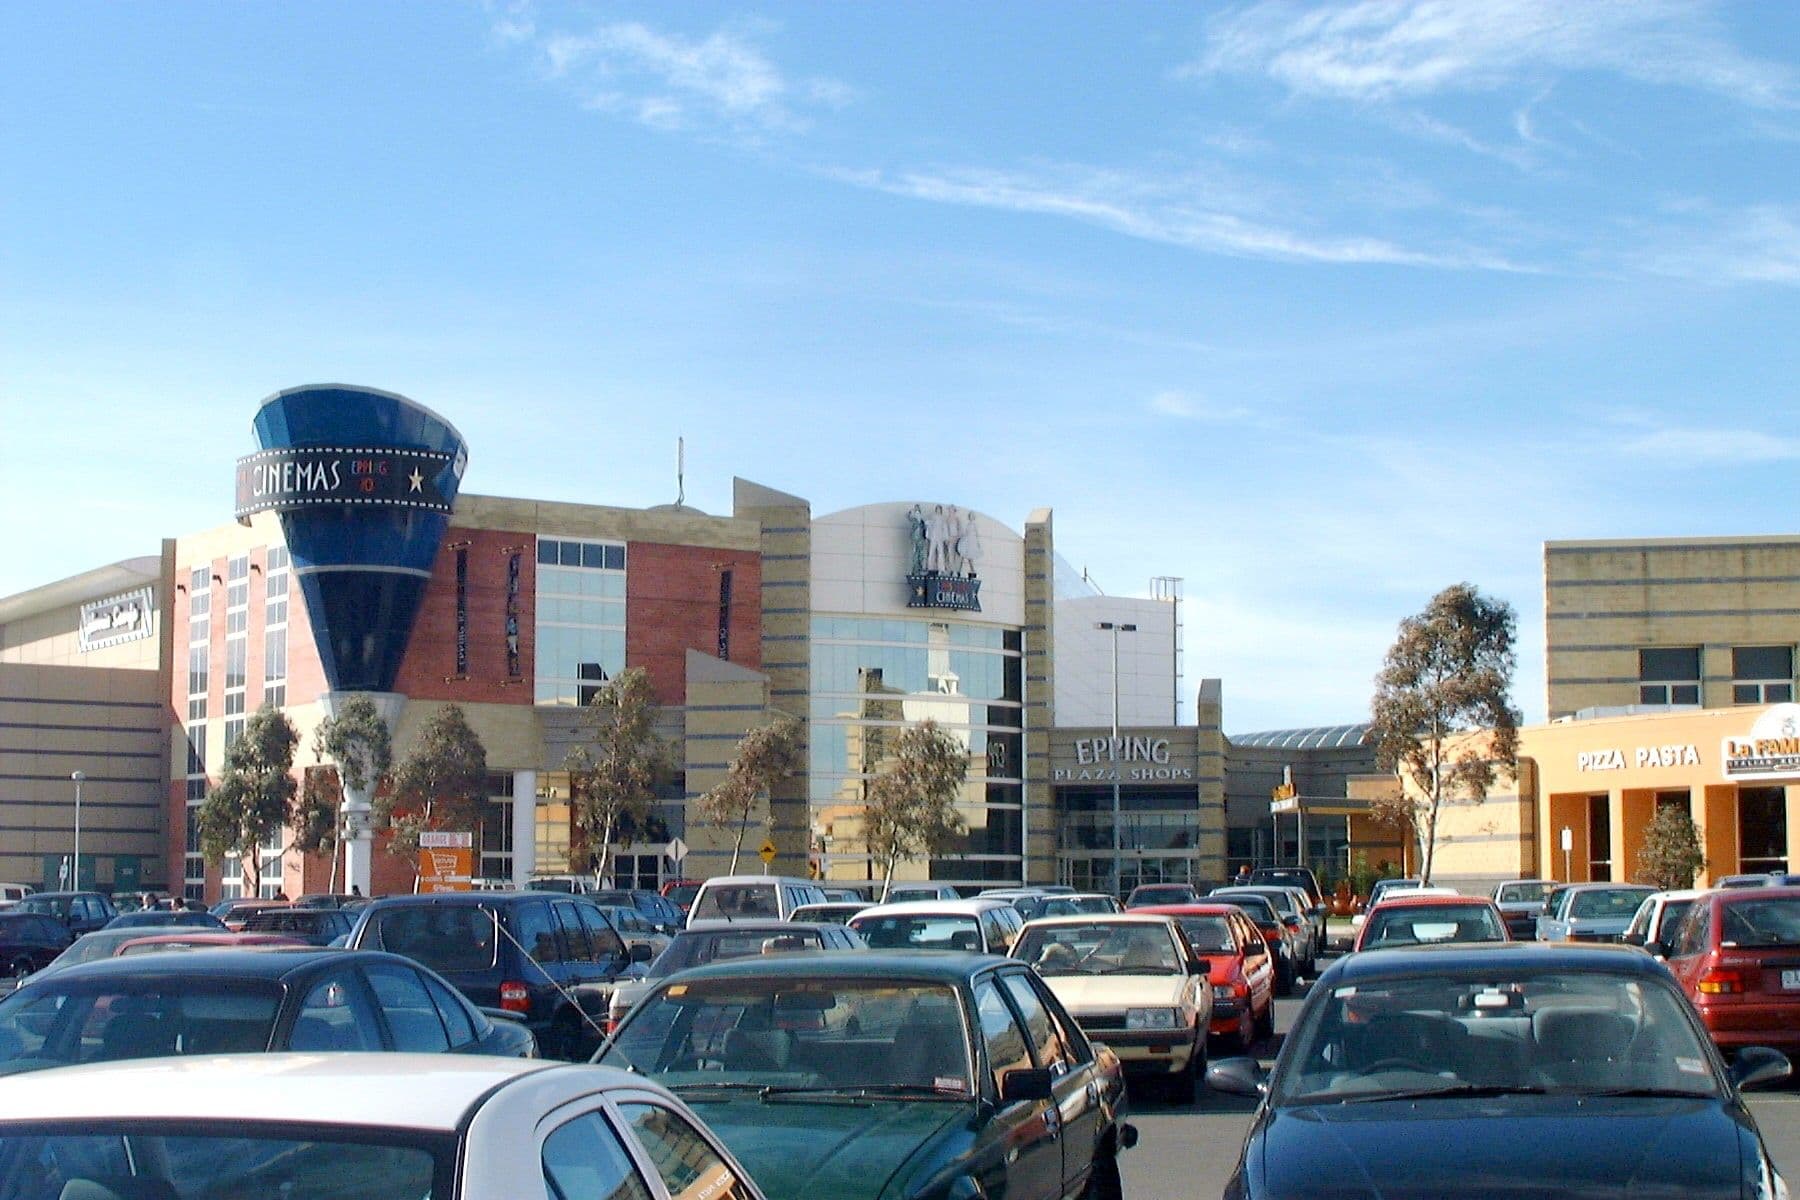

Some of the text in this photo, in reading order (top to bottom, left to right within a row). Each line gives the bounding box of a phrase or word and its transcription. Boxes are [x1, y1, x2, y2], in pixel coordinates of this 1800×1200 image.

[351, 459, 389, 475] EPPIG
[253, 460, 341, 497] CINEMAS
[1076, 736, 1170, 765] EPPING
[1577, 744, 1701, 771] PIZZA PASTA
[1727, 740, 1753, 758] La
[1054, 768, 1192, 781] PLAZA SHOPS
